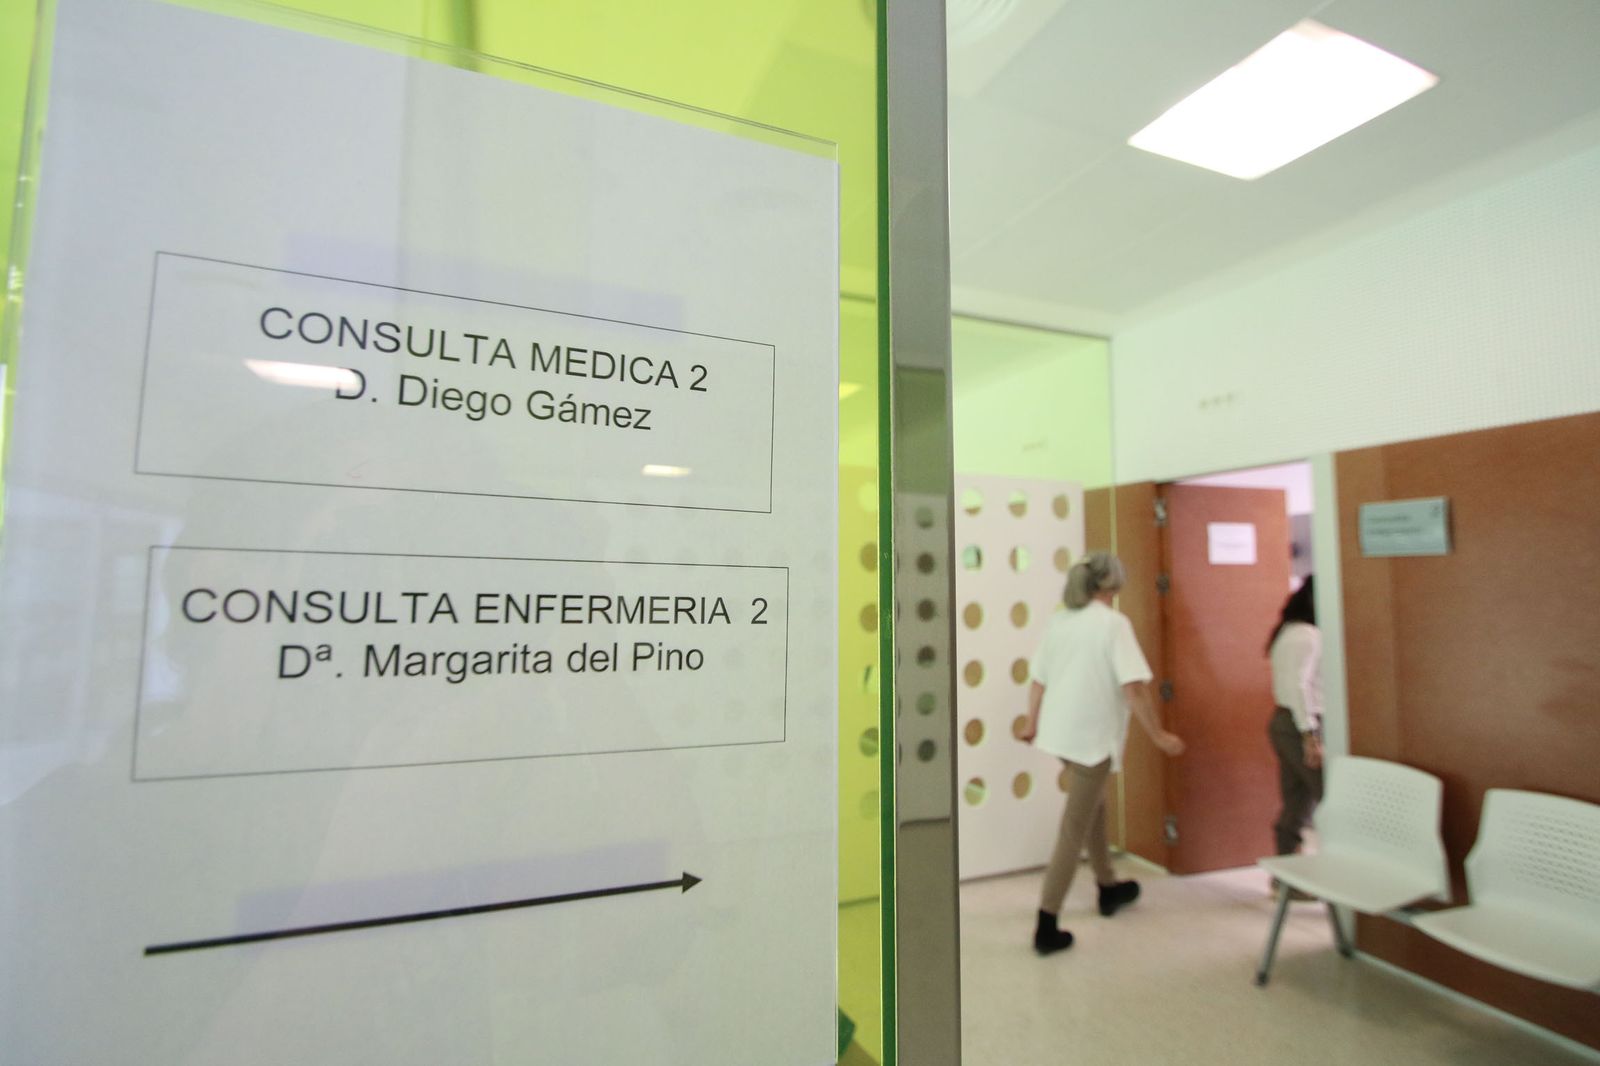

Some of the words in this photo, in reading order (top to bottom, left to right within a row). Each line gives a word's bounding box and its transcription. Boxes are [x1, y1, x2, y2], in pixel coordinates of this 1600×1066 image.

[259, 306, 517, 370] CONSULTA
[530, 341, 680, 389] MEDICA
[689, 364, 708, 393] 2
[397, 373, 512, 422] Diego
[526, 389, 652, 431] Gámez
[181, 587, 459, 625] CONSULTA
[474, 592, 732, 625] ENFERMERIA
[750, 597, 768, 625] 2
[363, 642, 553, 685] Margarita
[566, 641, 619, 674] del
[632, 641, 705, 672] Pino
